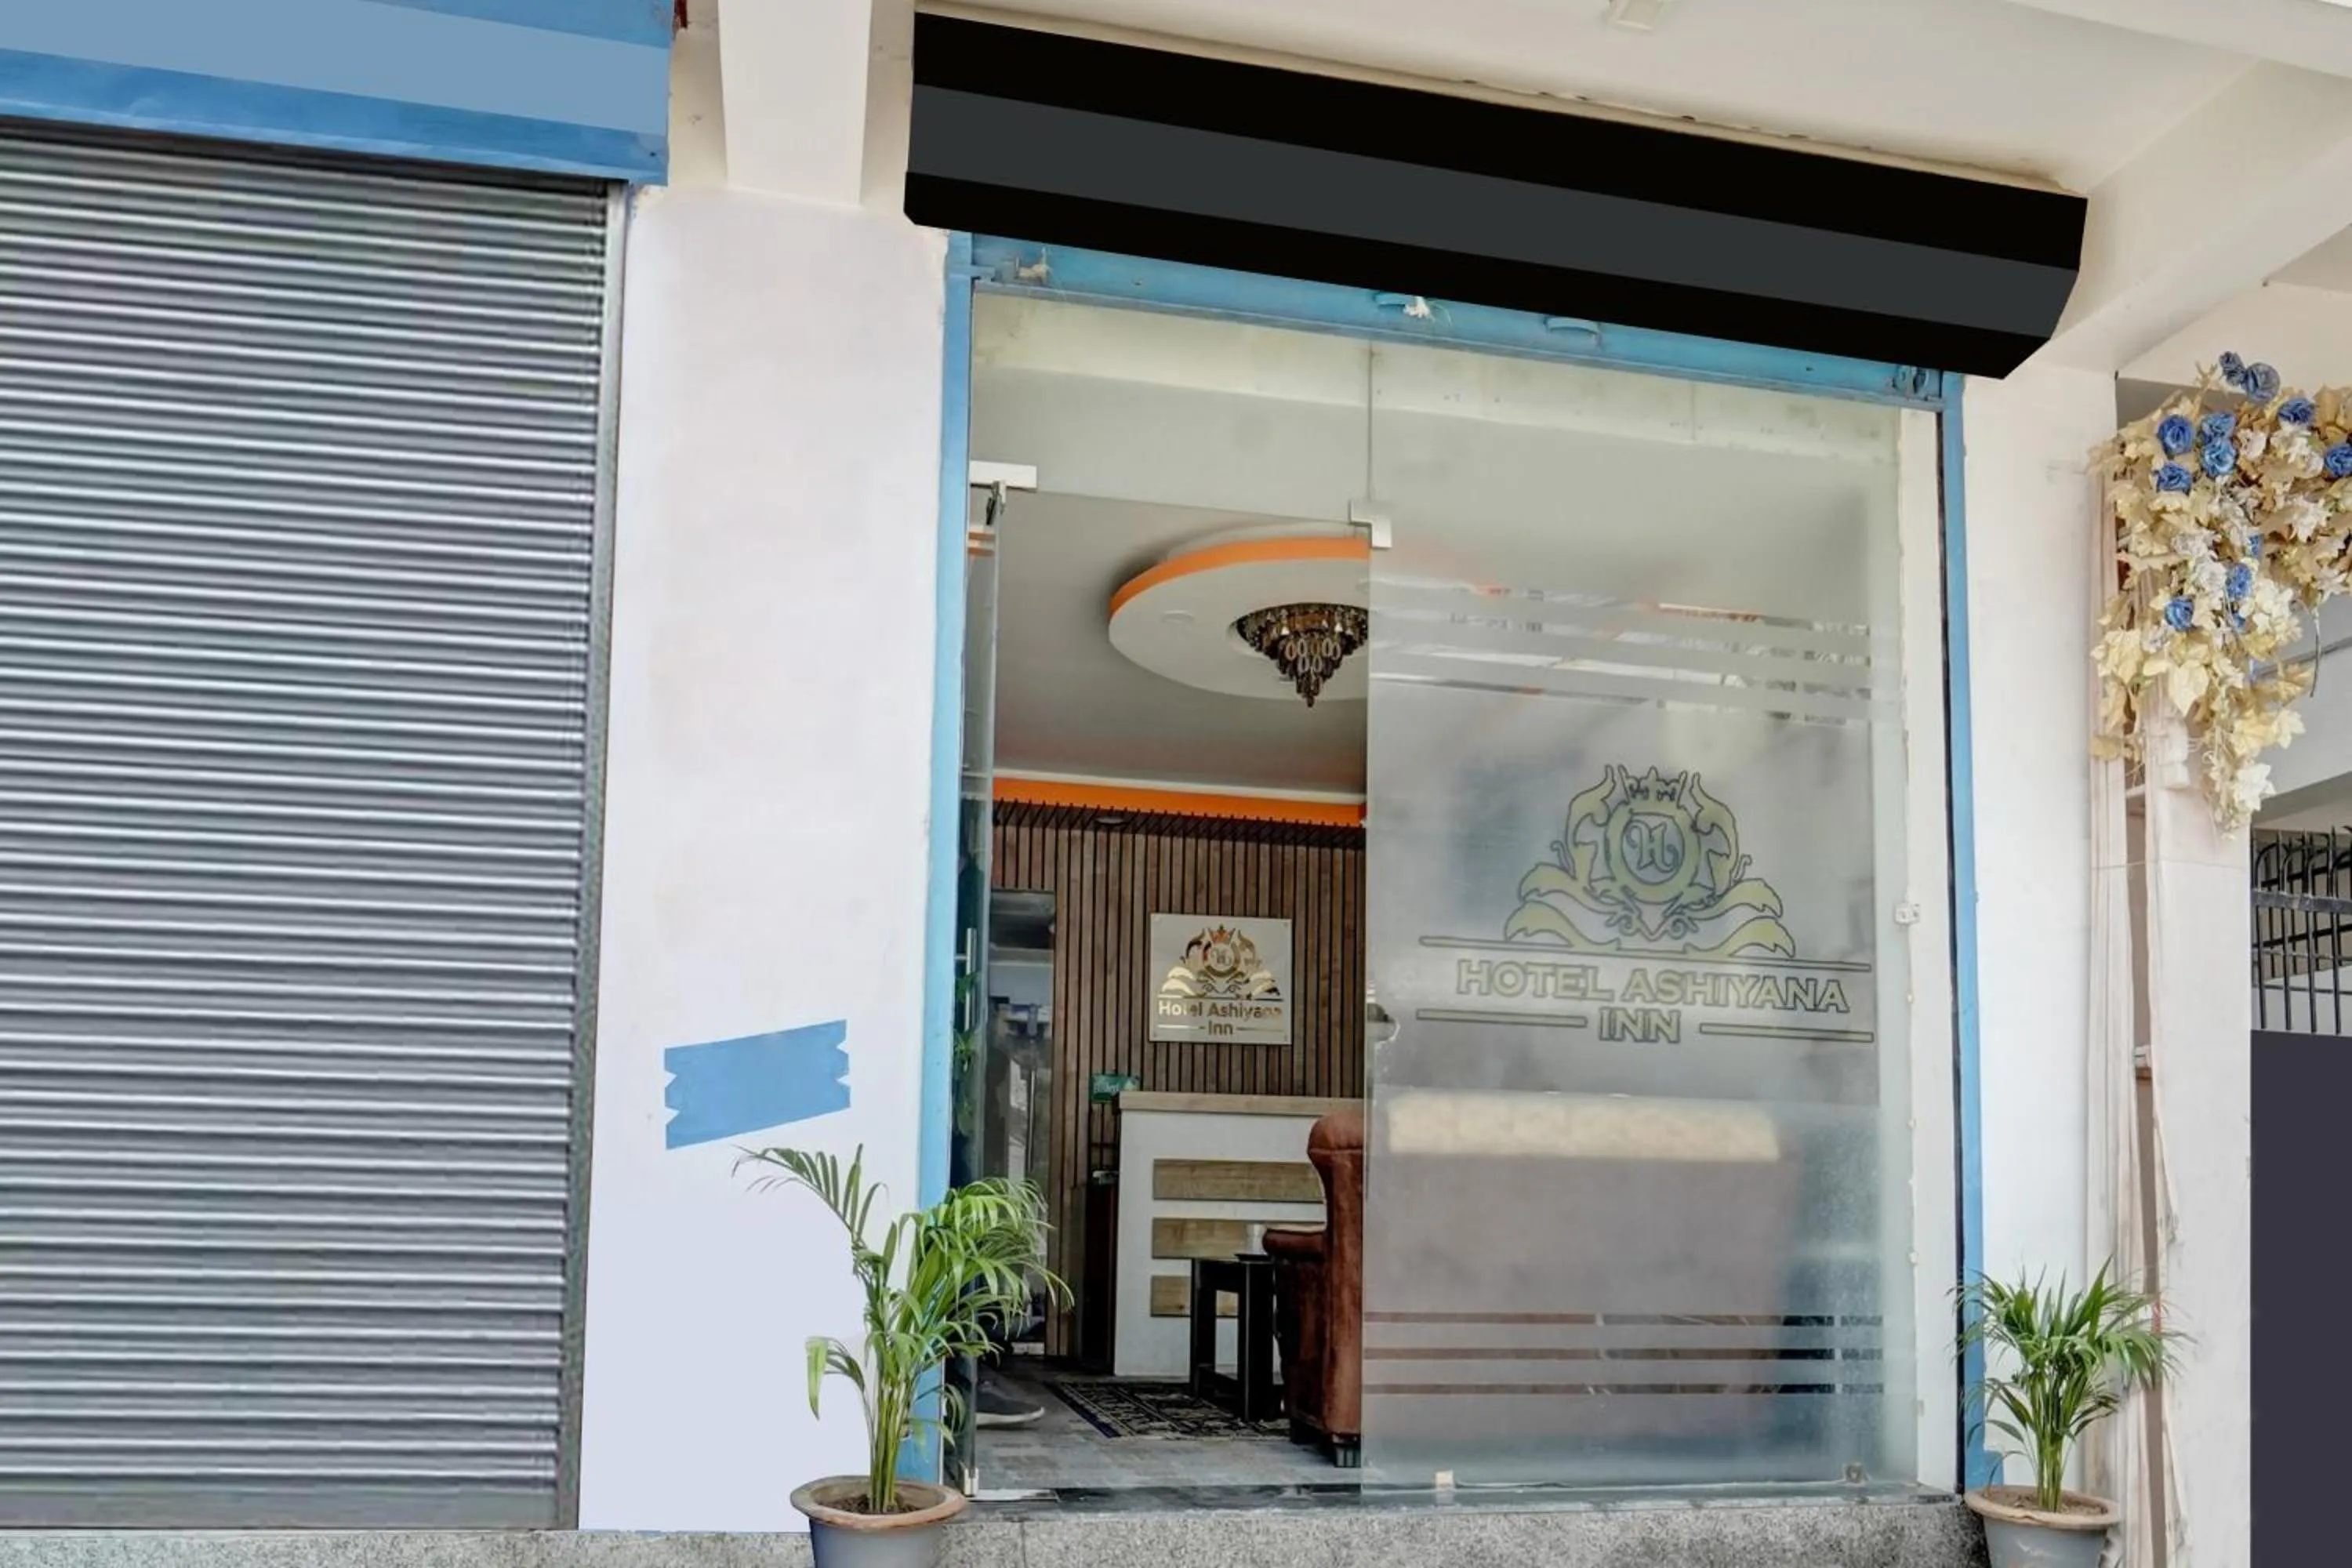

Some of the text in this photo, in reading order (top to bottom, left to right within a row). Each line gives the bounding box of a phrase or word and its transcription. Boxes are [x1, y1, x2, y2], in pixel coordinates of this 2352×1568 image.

[1457, 958, 1850, 1014] HOTEL ASHIYANA
[1158, 1000, 1203, 1017] Hotel
[1208, 1022, 1233, 1036] Inn
[1599, 1007, 1682, 1044] INN
